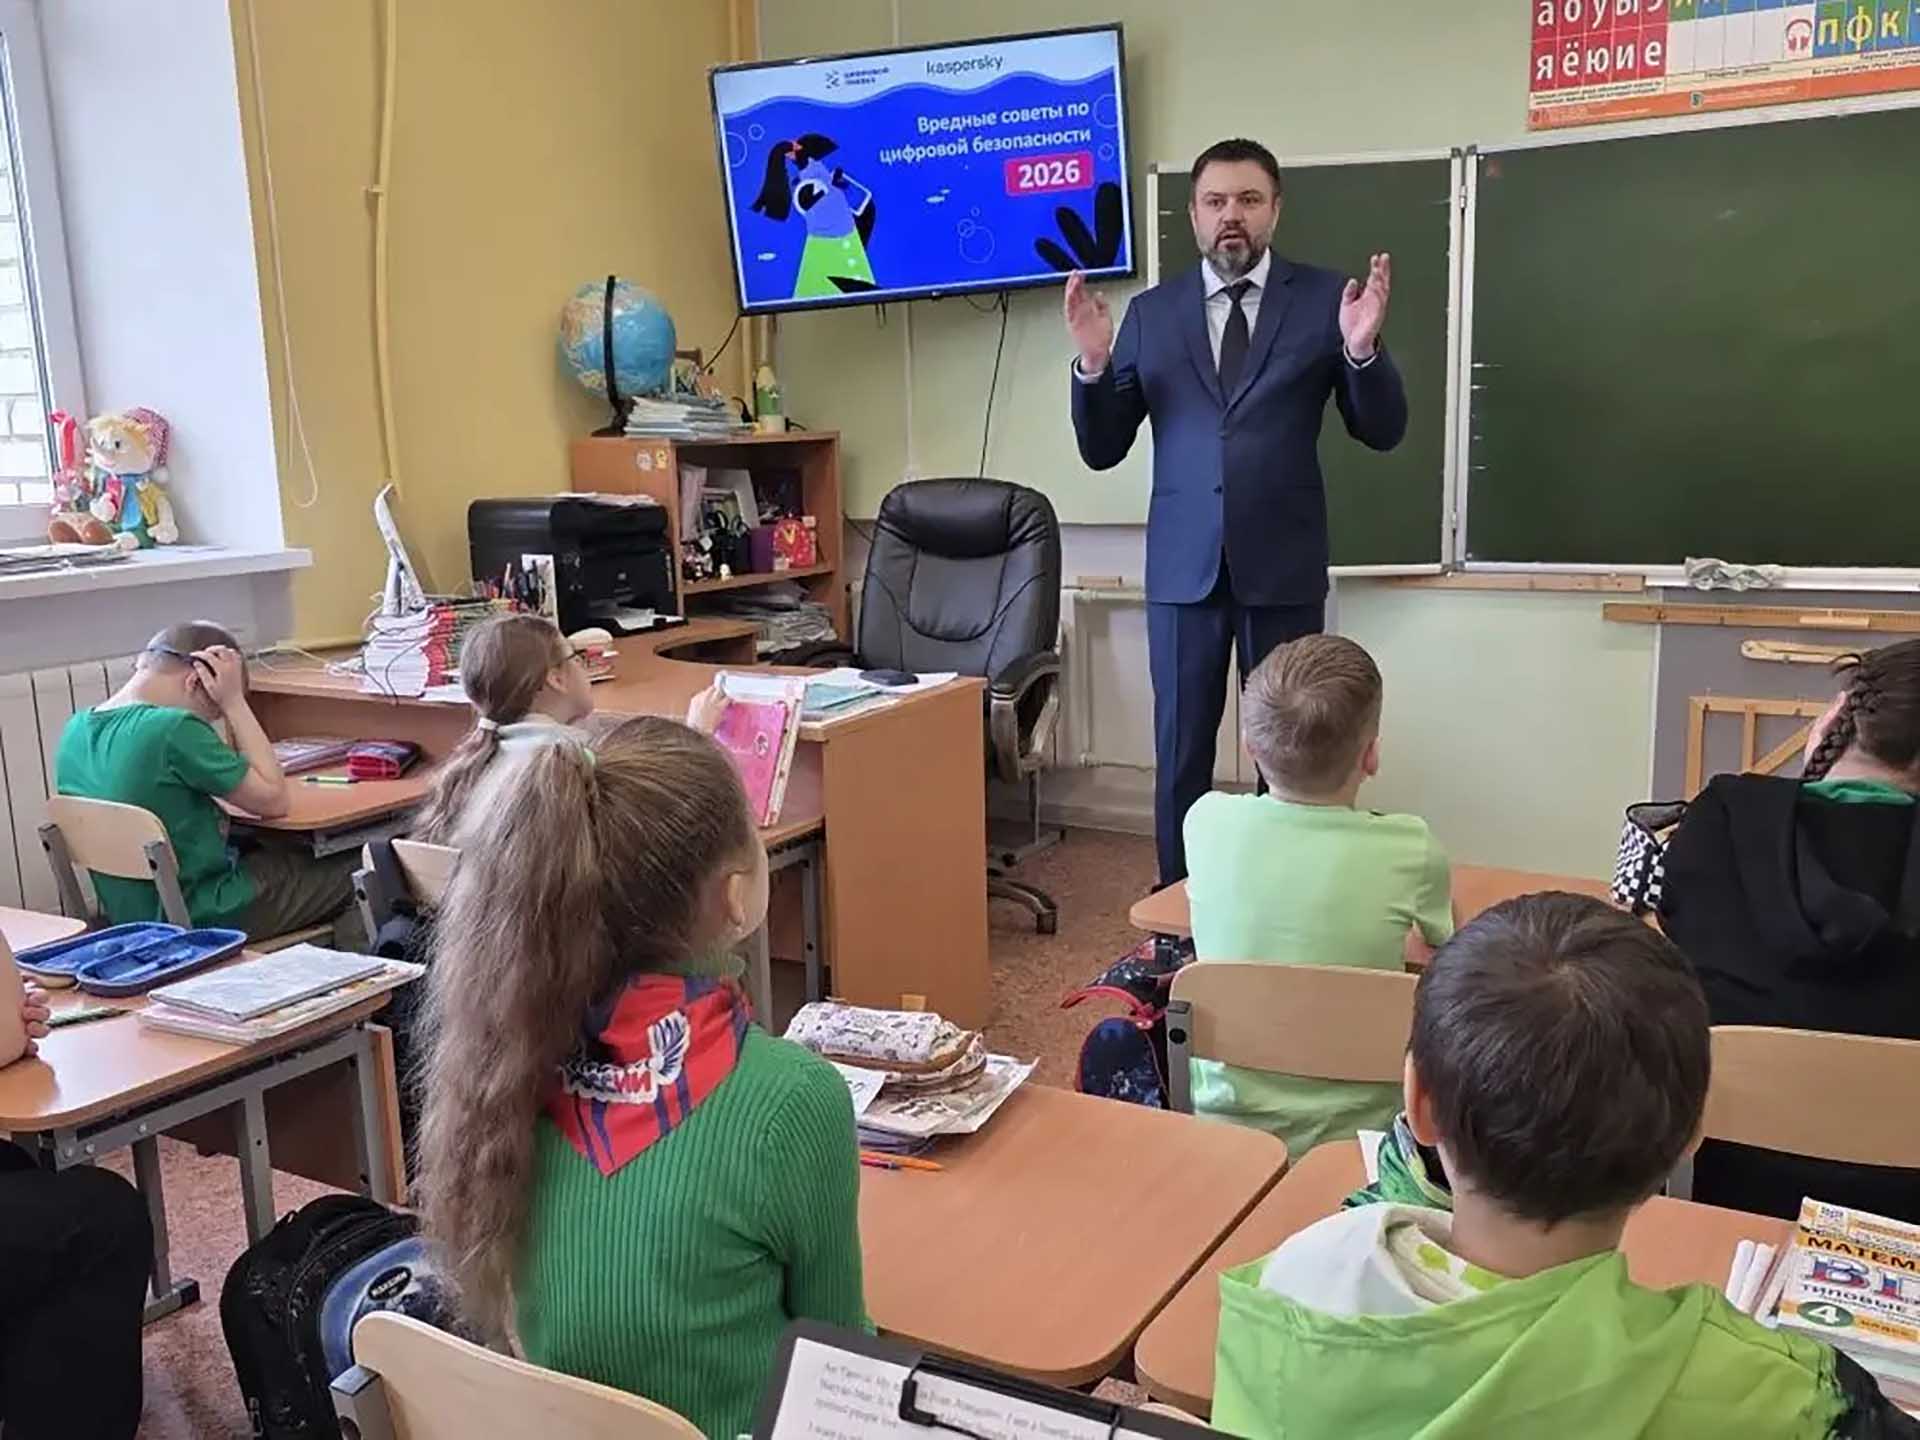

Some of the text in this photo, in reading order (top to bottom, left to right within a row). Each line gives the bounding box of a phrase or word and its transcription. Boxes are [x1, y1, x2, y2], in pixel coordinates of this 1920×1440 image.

[926, 55, 1004, 75] kaspersky
[917, 102, 1089, 134] Вредные советы по
[880, 128, 1092, 165] цифровой безопасности
[1018, 160, 1081, 188] 2026
[1808, 1305, 1840, 1324] 4
